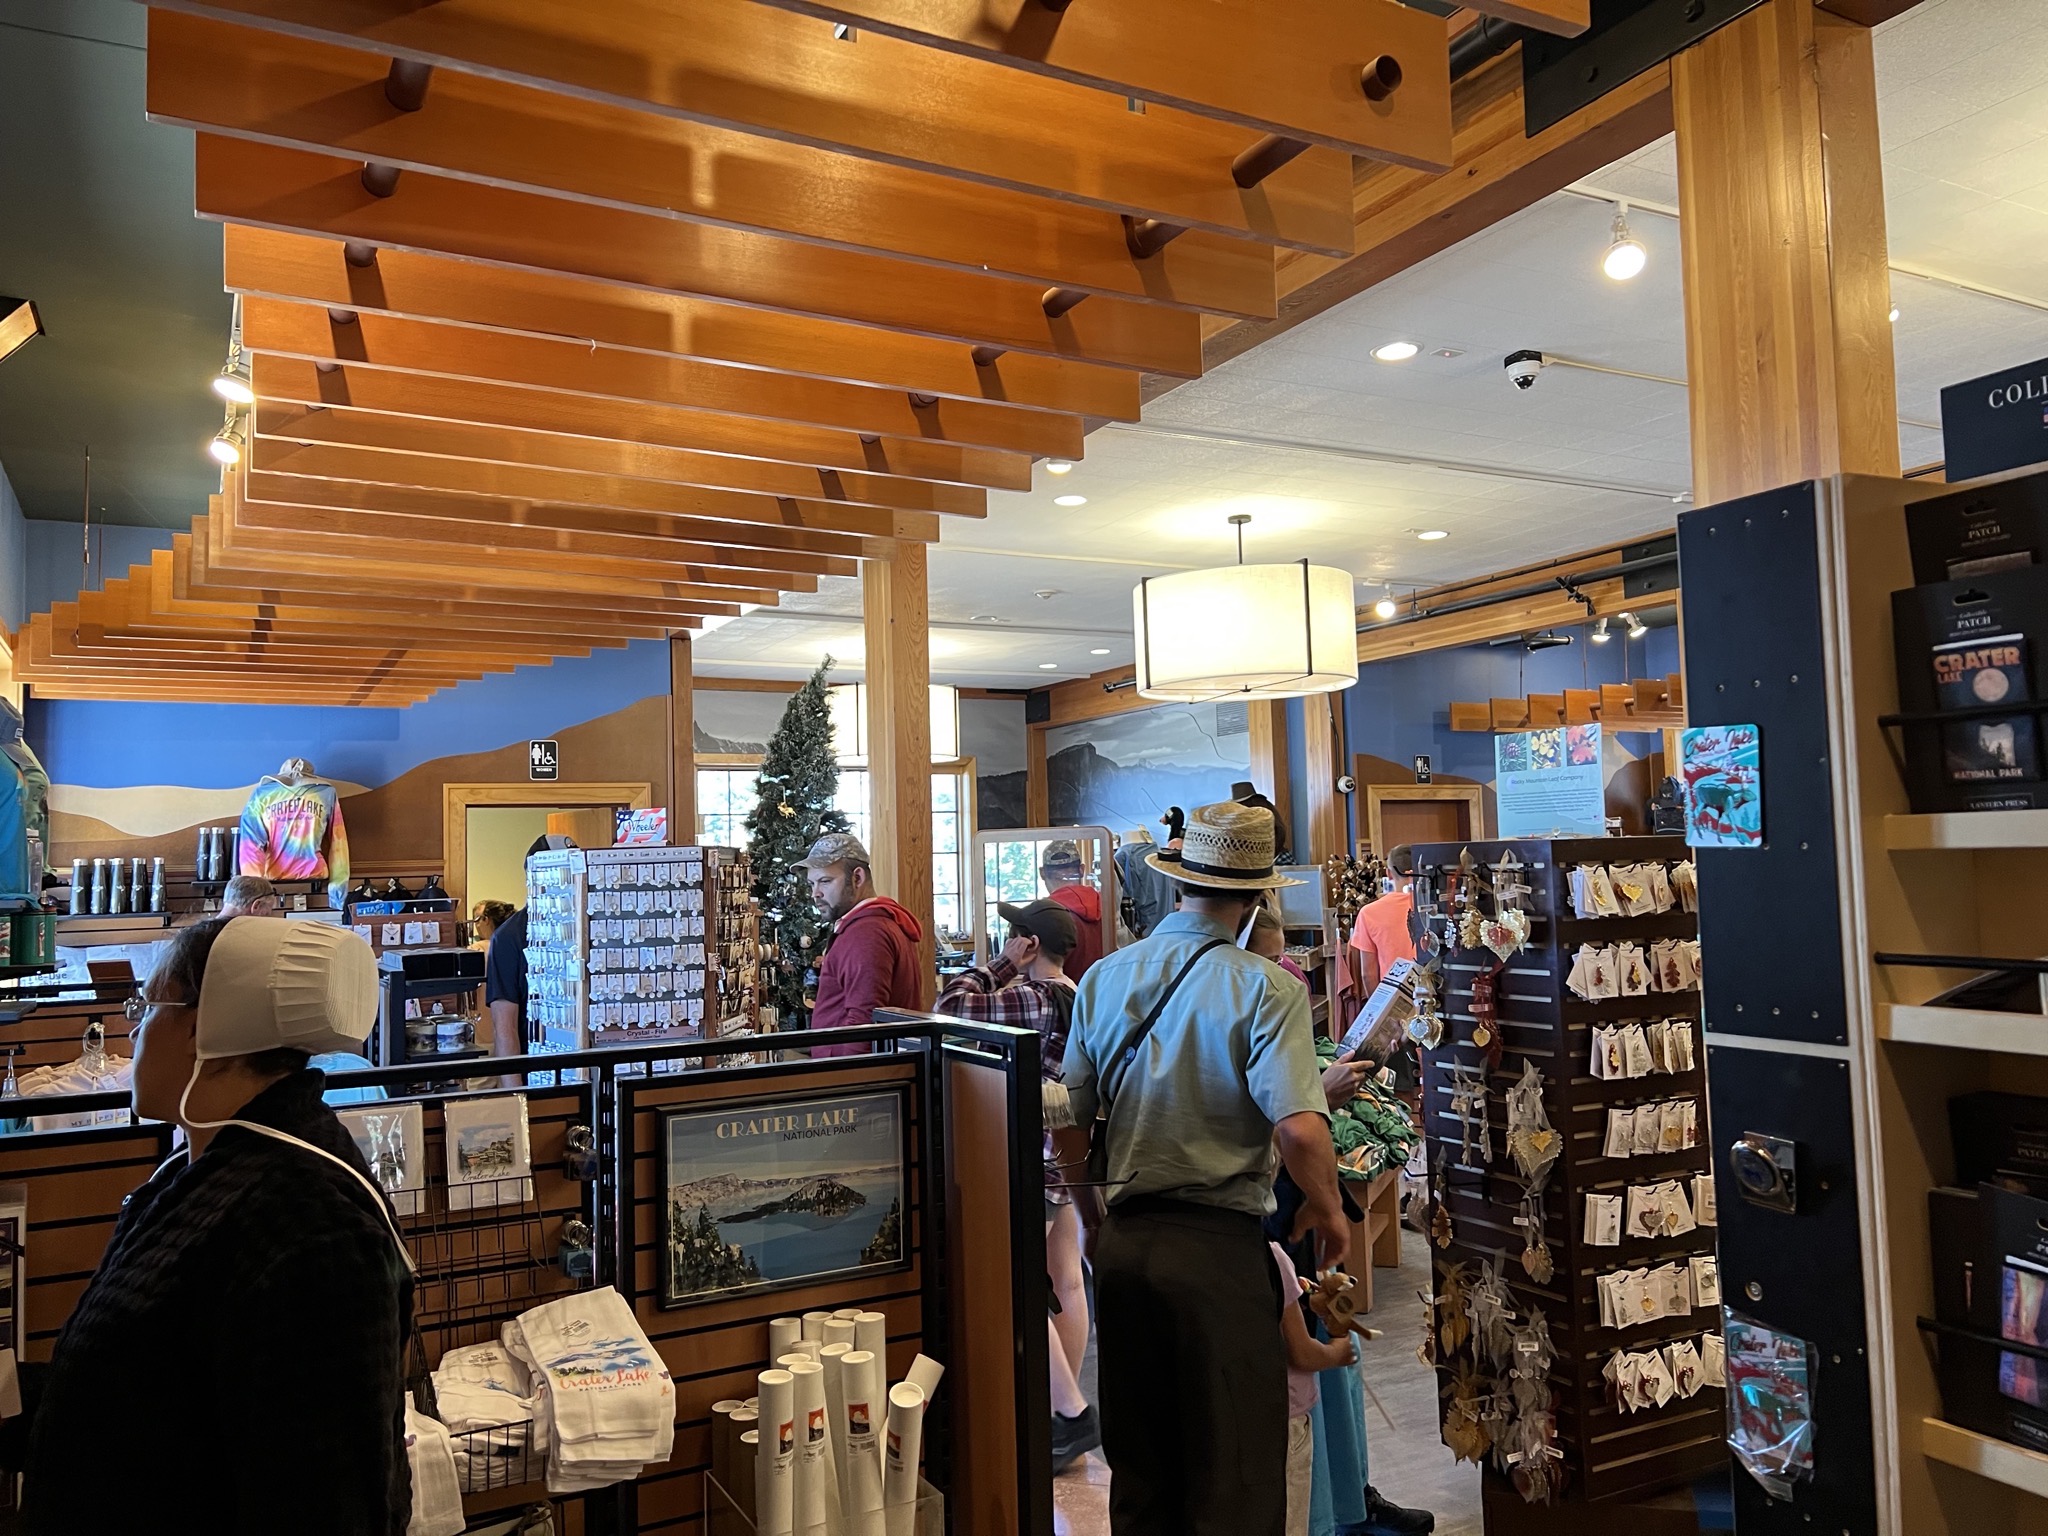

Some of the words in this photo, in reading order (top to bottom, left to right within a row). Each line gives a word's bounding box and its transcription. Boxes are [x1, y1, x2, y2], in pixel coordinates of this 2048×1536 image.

[1968, 525, 2001, 539] PATCH
[1957, 615, 1991, 629] PATCH
[1933, 646, 2021, 674] CRATER
[1937, 671, 1963, 684] LAKE
[1685, 733, 1721, 758] Crater
[1725, 726, 1754, 751] Lake
[1952, 769, 1997, 780] NATIONAL
[1999, 767, 2024, 778] PARK
[265, 799, 300, 820] CRATER
[302, 799, 324, 819] LAKE
[1969, 801, 2004, 809] LANTERN
[622, 815, 659, 834] Wheeler
[716, 1115, 800, 1139] CRATER
[805, 1108, 859, 1128] LAKE
[783, 1128, 831, 1141] NATIONAL
[833, 1124, 857, 1135] PARK
[462, 1170, 488, 1182] Crater
[489, 1166, 510, 1178] Lake
[560, 1374, 615, 1389] Crater
[617, 1367, 650, 1384] Lake
[579, 1383, 619, 1392] NATIONAL
